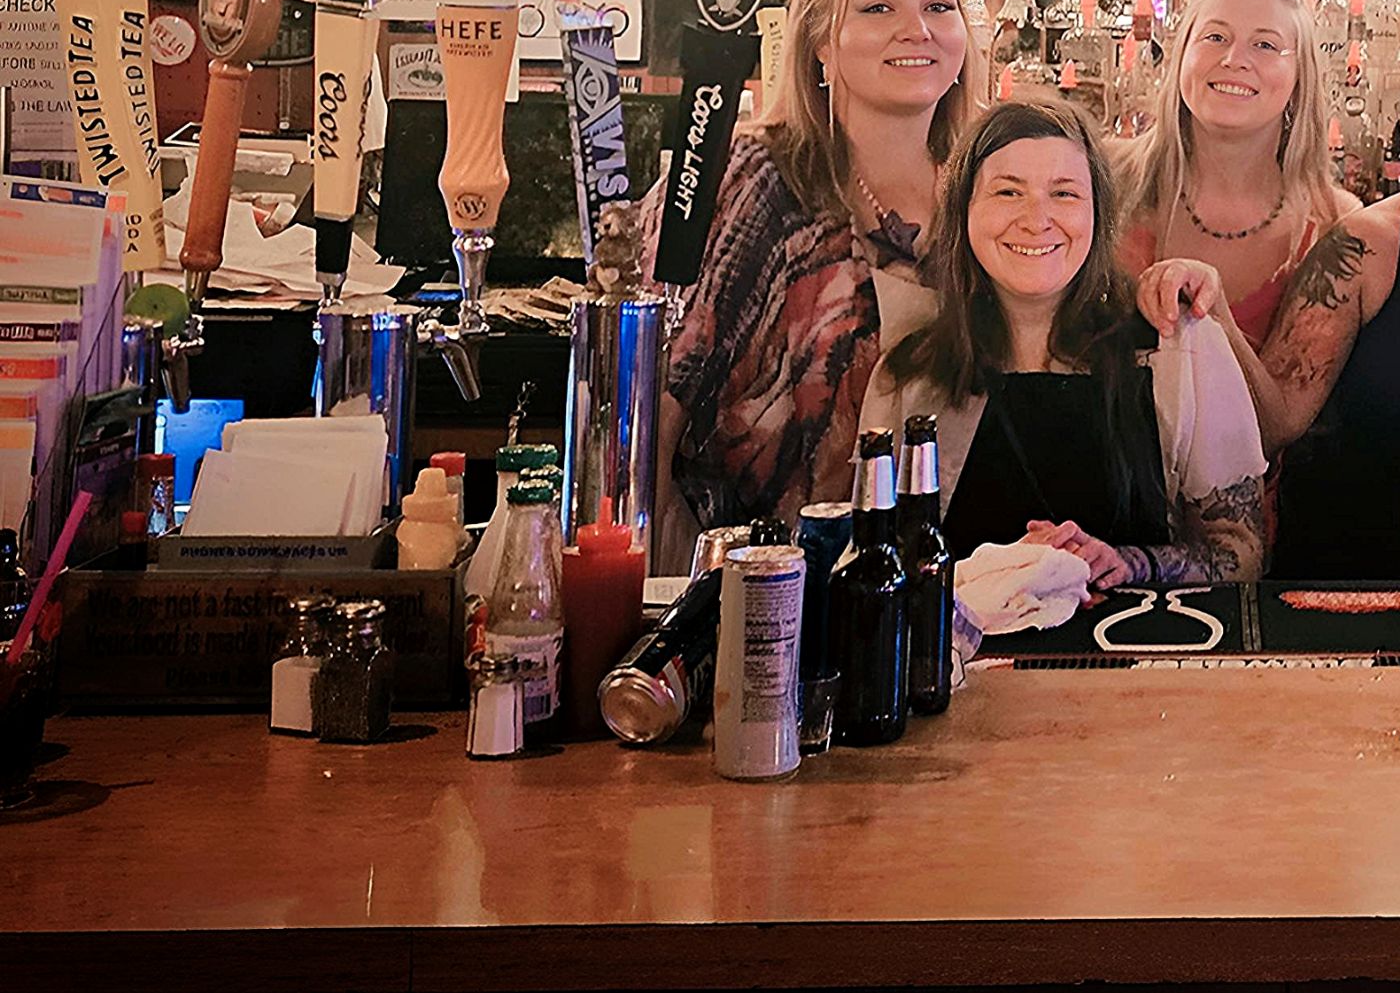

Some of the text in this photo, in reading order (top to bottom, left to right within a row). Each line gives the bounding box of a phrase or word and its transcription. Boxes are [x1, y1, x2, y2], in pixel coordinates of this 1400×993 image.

[121, 10, 146, 59] TEA
[441, 18, 502, 39] HEFE
[69, 15, 129, 185] TWISTED TEA
[125, 68, 161, 178] TWISTED
[319, 72, 347, 160] Coors
[593, 126, 629, 198] VIS
[673, 84, 724, 221] Coors LIGHT
